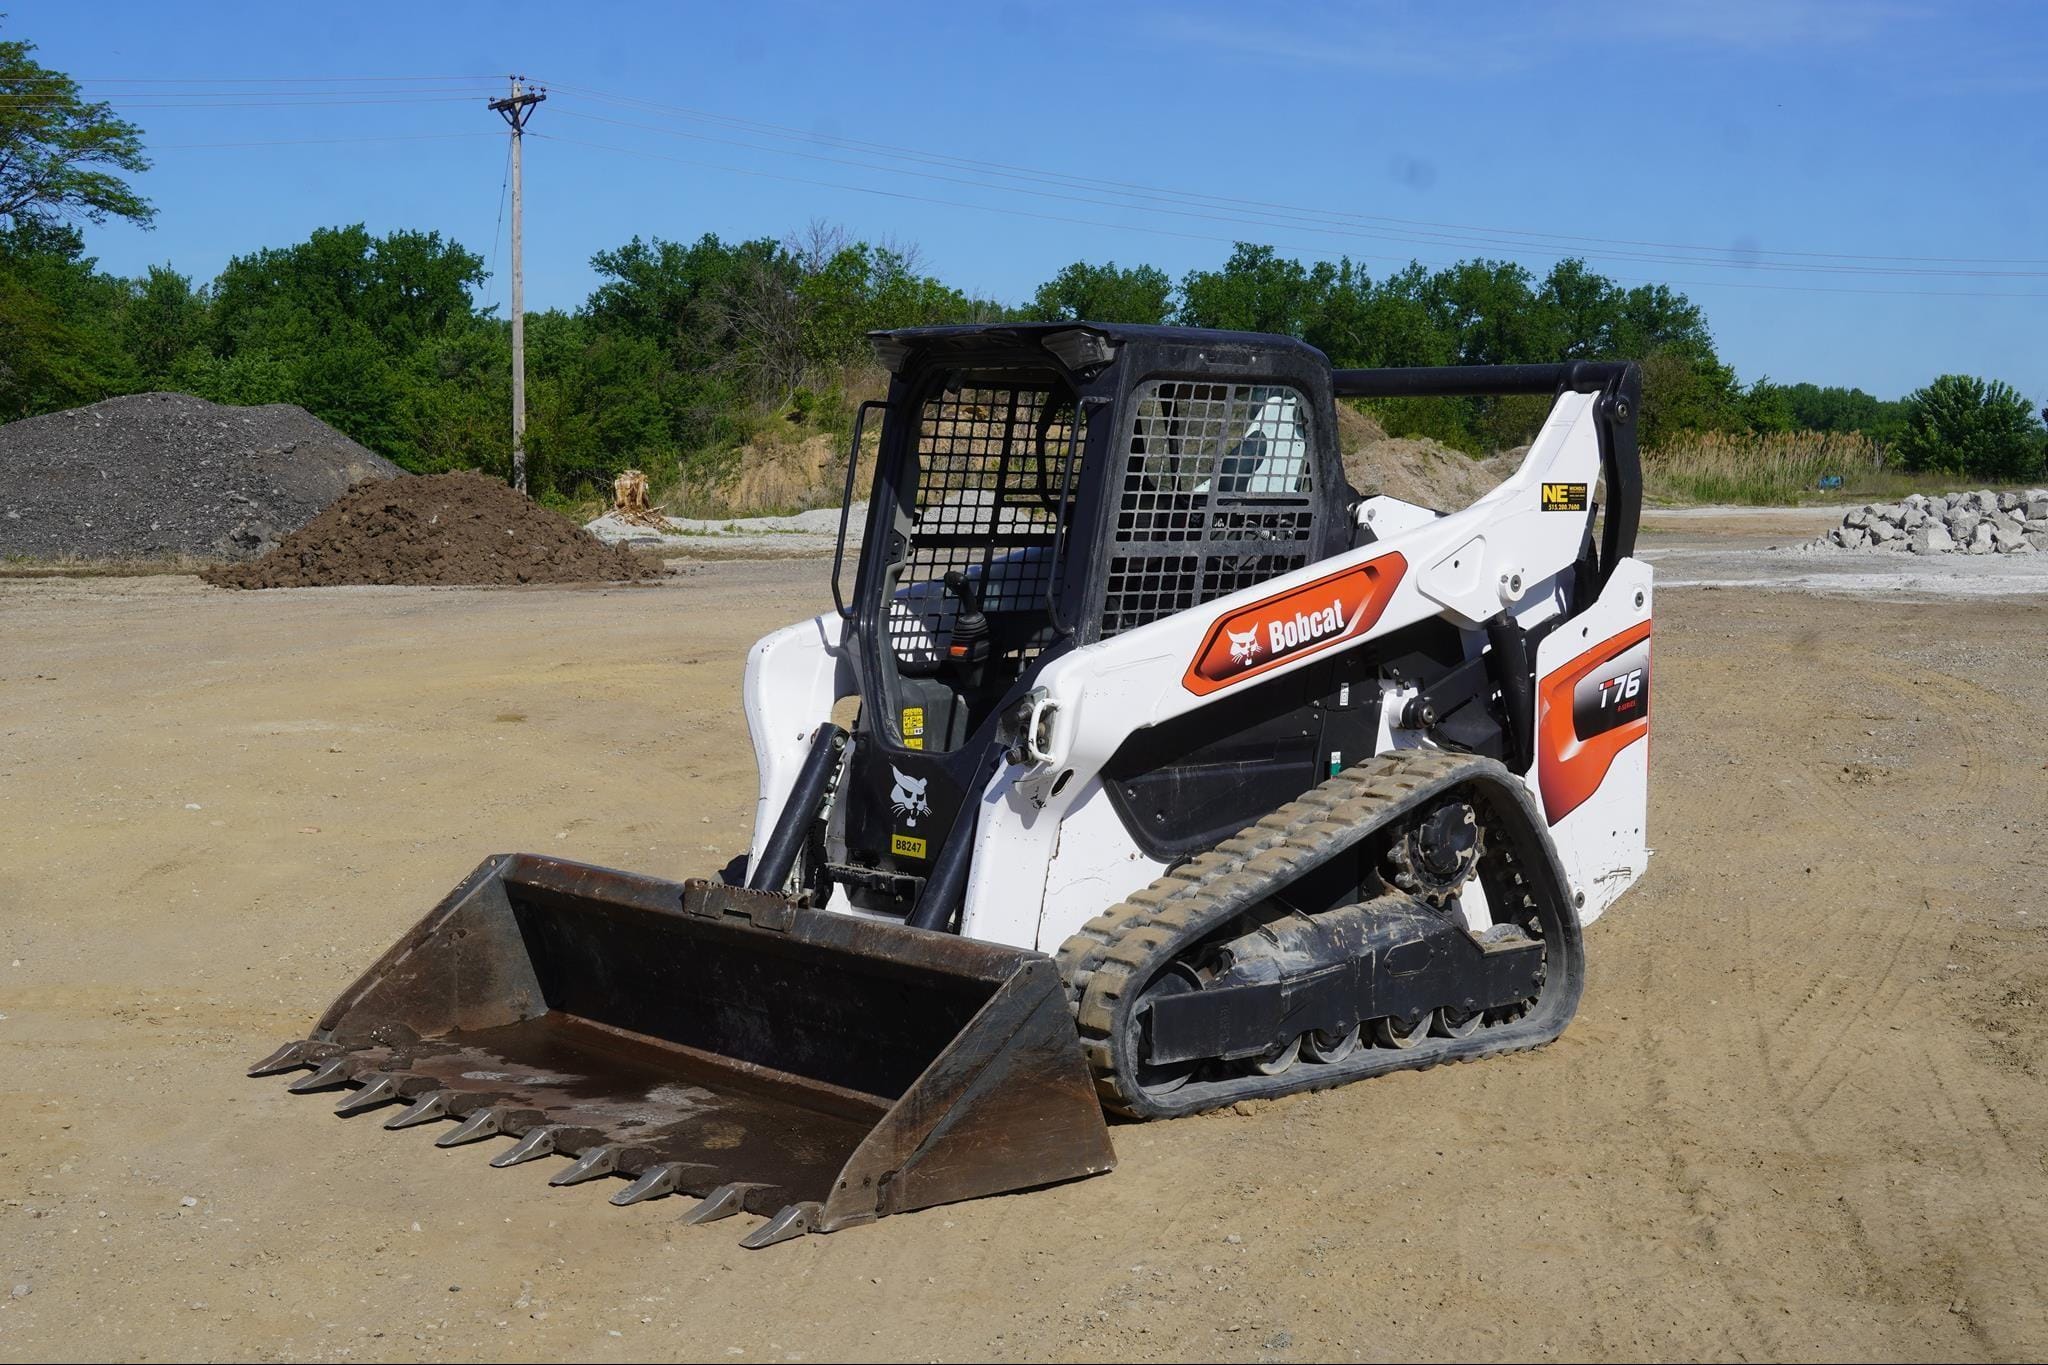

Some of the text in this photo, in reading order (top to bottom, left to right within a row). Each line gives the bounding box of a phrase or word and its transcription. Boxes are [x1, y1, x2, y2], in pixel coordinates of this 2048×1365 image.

[1543, 485, 1568, 503] NE
[1268, 599, 1345, 653] Bobcat
[1599, 668, 1642, 708] T76
[896, 839, 922, 853] B8247
